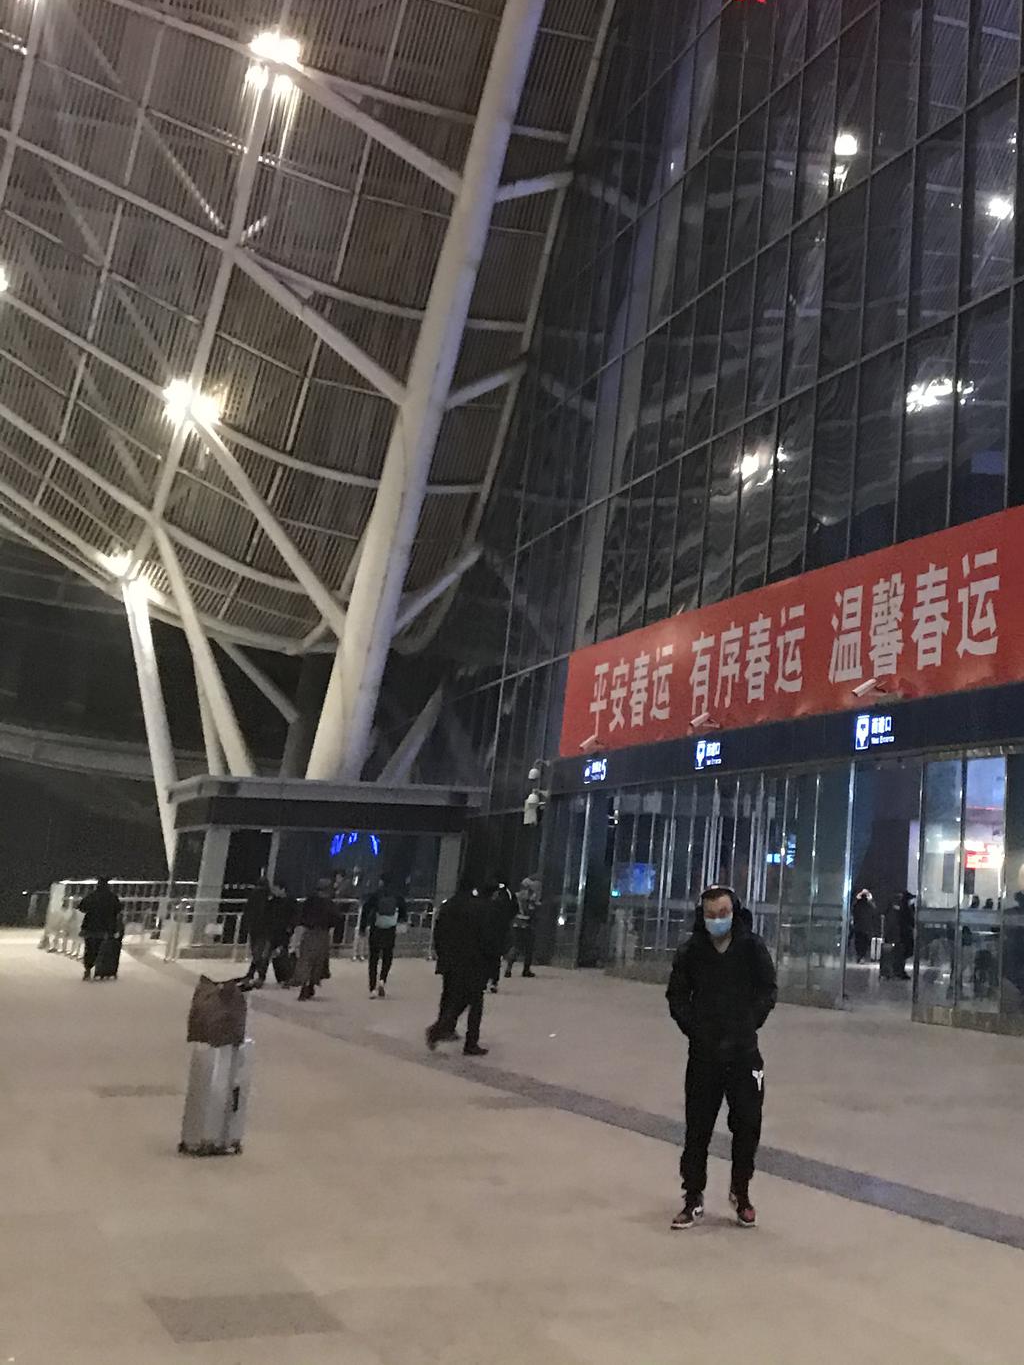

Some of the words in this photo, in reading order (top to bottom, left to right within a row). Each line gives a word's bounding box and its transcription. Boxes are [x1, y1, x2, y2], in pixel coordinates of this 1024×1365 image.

[588, 644, 674, 740] 平安春运
[688, 604, 806, 717] 有序春运
[828, 548, 1000, 685] 温馨春运
